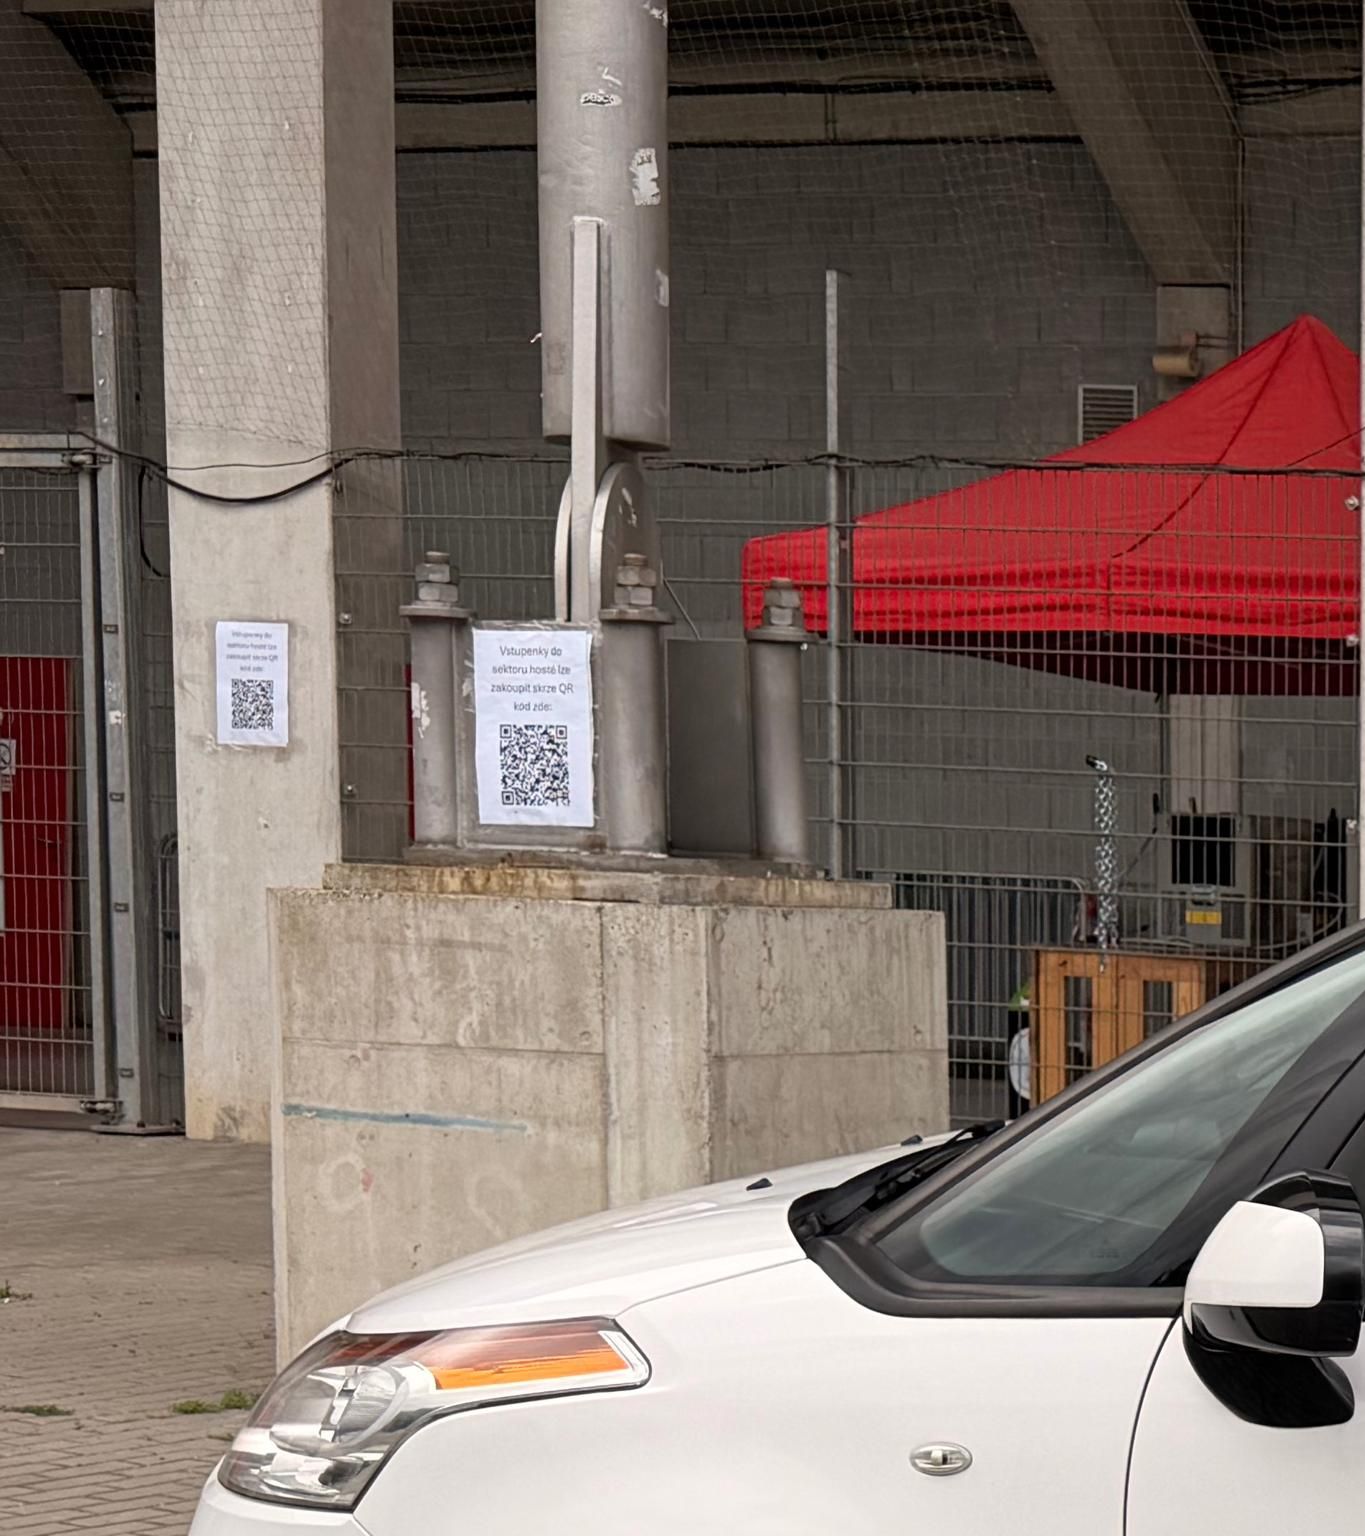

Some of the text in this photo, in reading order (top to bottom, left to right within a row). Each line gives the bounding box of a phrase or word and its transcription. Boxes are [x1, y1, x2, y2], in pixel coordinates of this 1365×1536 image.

[499, 645, 563, 658] Vstupenky do
[558, 664, 571, 675] lze
[491, 683, 531, 694] zakoupit
[559, 682, 574, 695] QR
